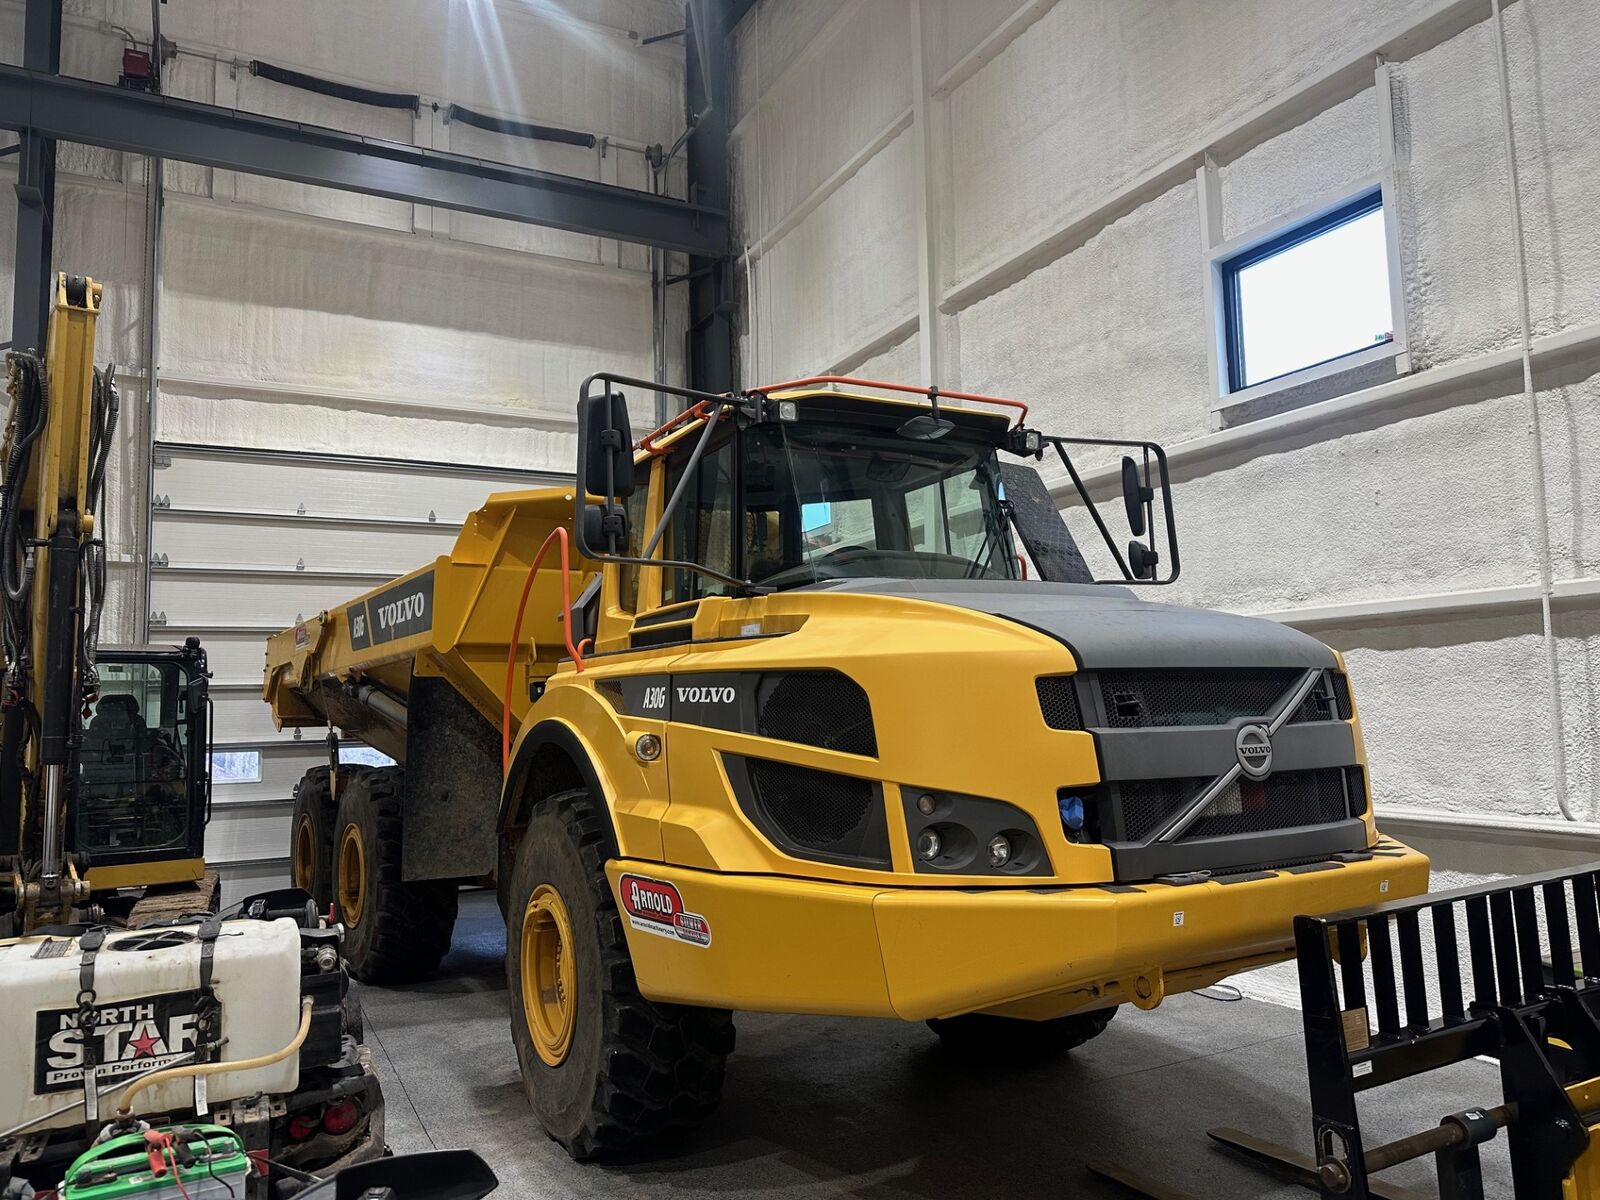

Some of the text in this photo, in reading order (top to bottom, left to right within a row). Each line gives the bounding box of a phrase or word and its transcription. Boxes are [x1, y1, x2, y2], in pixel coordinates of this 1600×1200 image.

[378, 592, 425, 630] VOLVO
[642, 687, 736, 709] A30G VOLVO
[1239, 745, 1271, 755] VOLVO
[631, 881, 673, 914] ARNOLD
[46, 1013, 204, 1069] STAR
[53, 1065, 106, 1081] Pron
